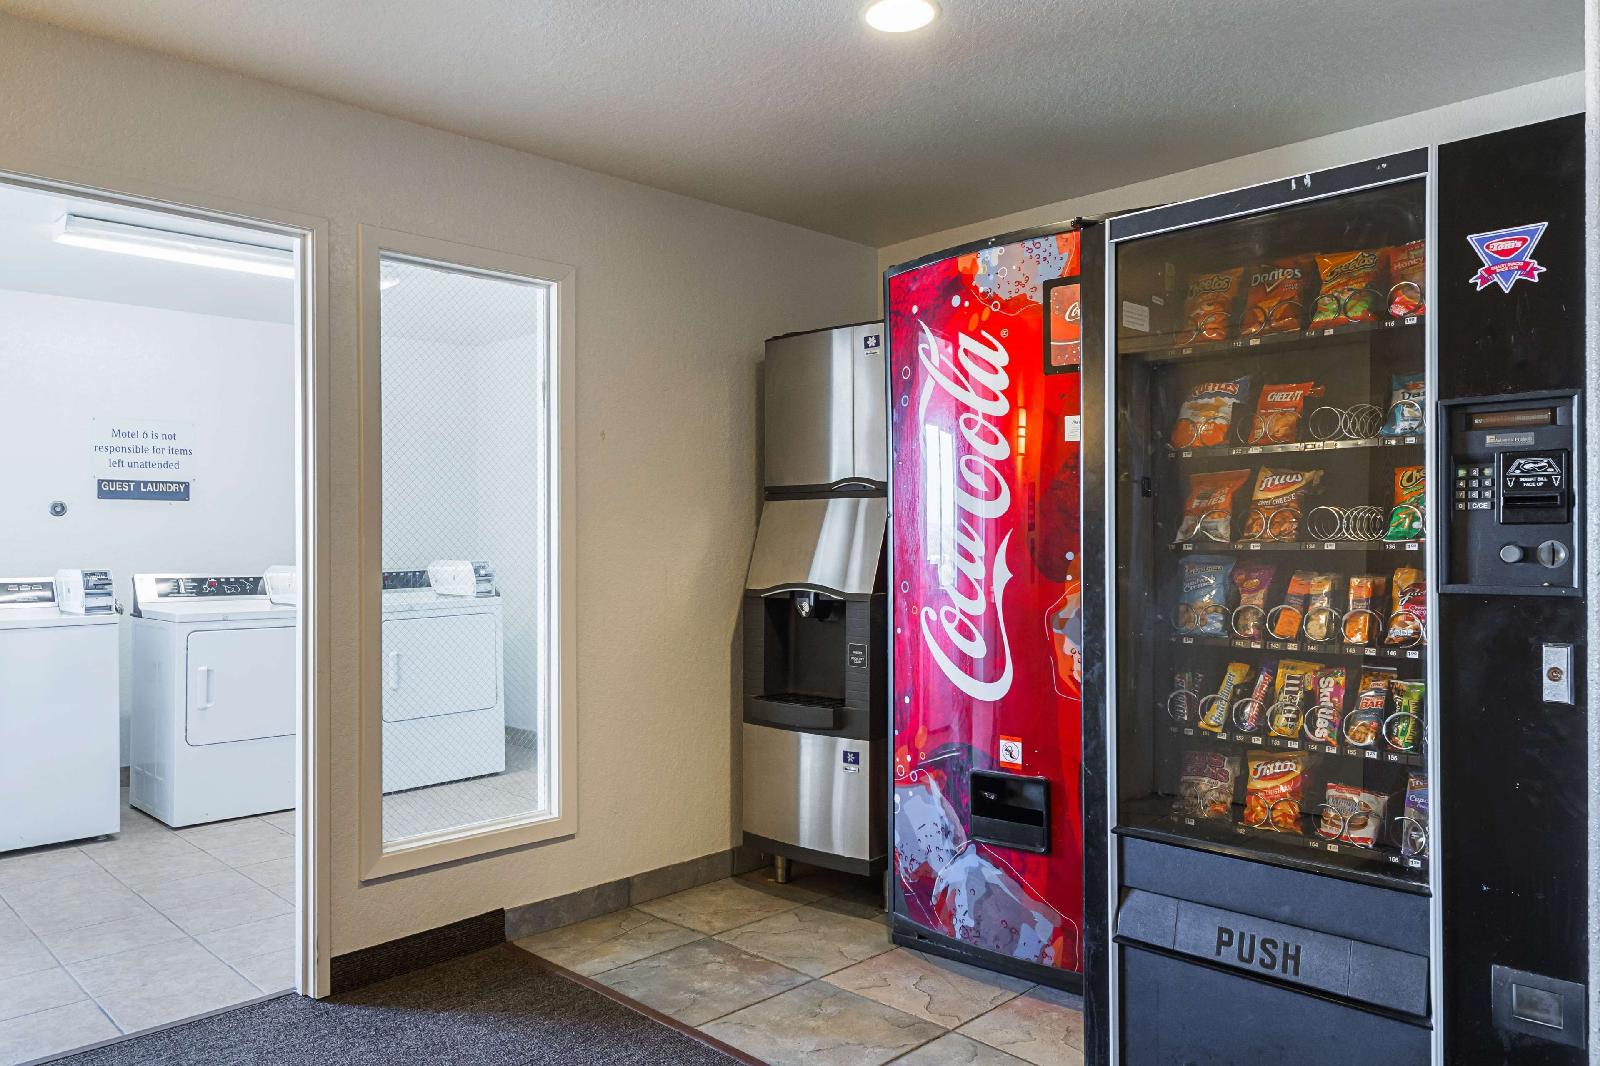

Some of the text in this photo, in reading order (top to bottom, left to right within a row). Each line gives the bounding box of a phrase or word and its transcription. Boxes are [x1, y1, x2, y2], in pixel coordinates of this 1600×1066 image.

[1251, 268, 1302, 287] Doritos
[111, 428, 177, 441] Motel 6 is not
[94, 444, 193, 456] responsible for items
[108, 458, 180, 470] left unattended
[101, 481, 186, 492] GUEST LAUNDRY
[1272, 492, 1296, 505] CHEESE
[1314, 676, 1335, 739] Skittles
[1359, 700, 1385, 710] BAR
[1215, 926, 1302, 977] PUSH
